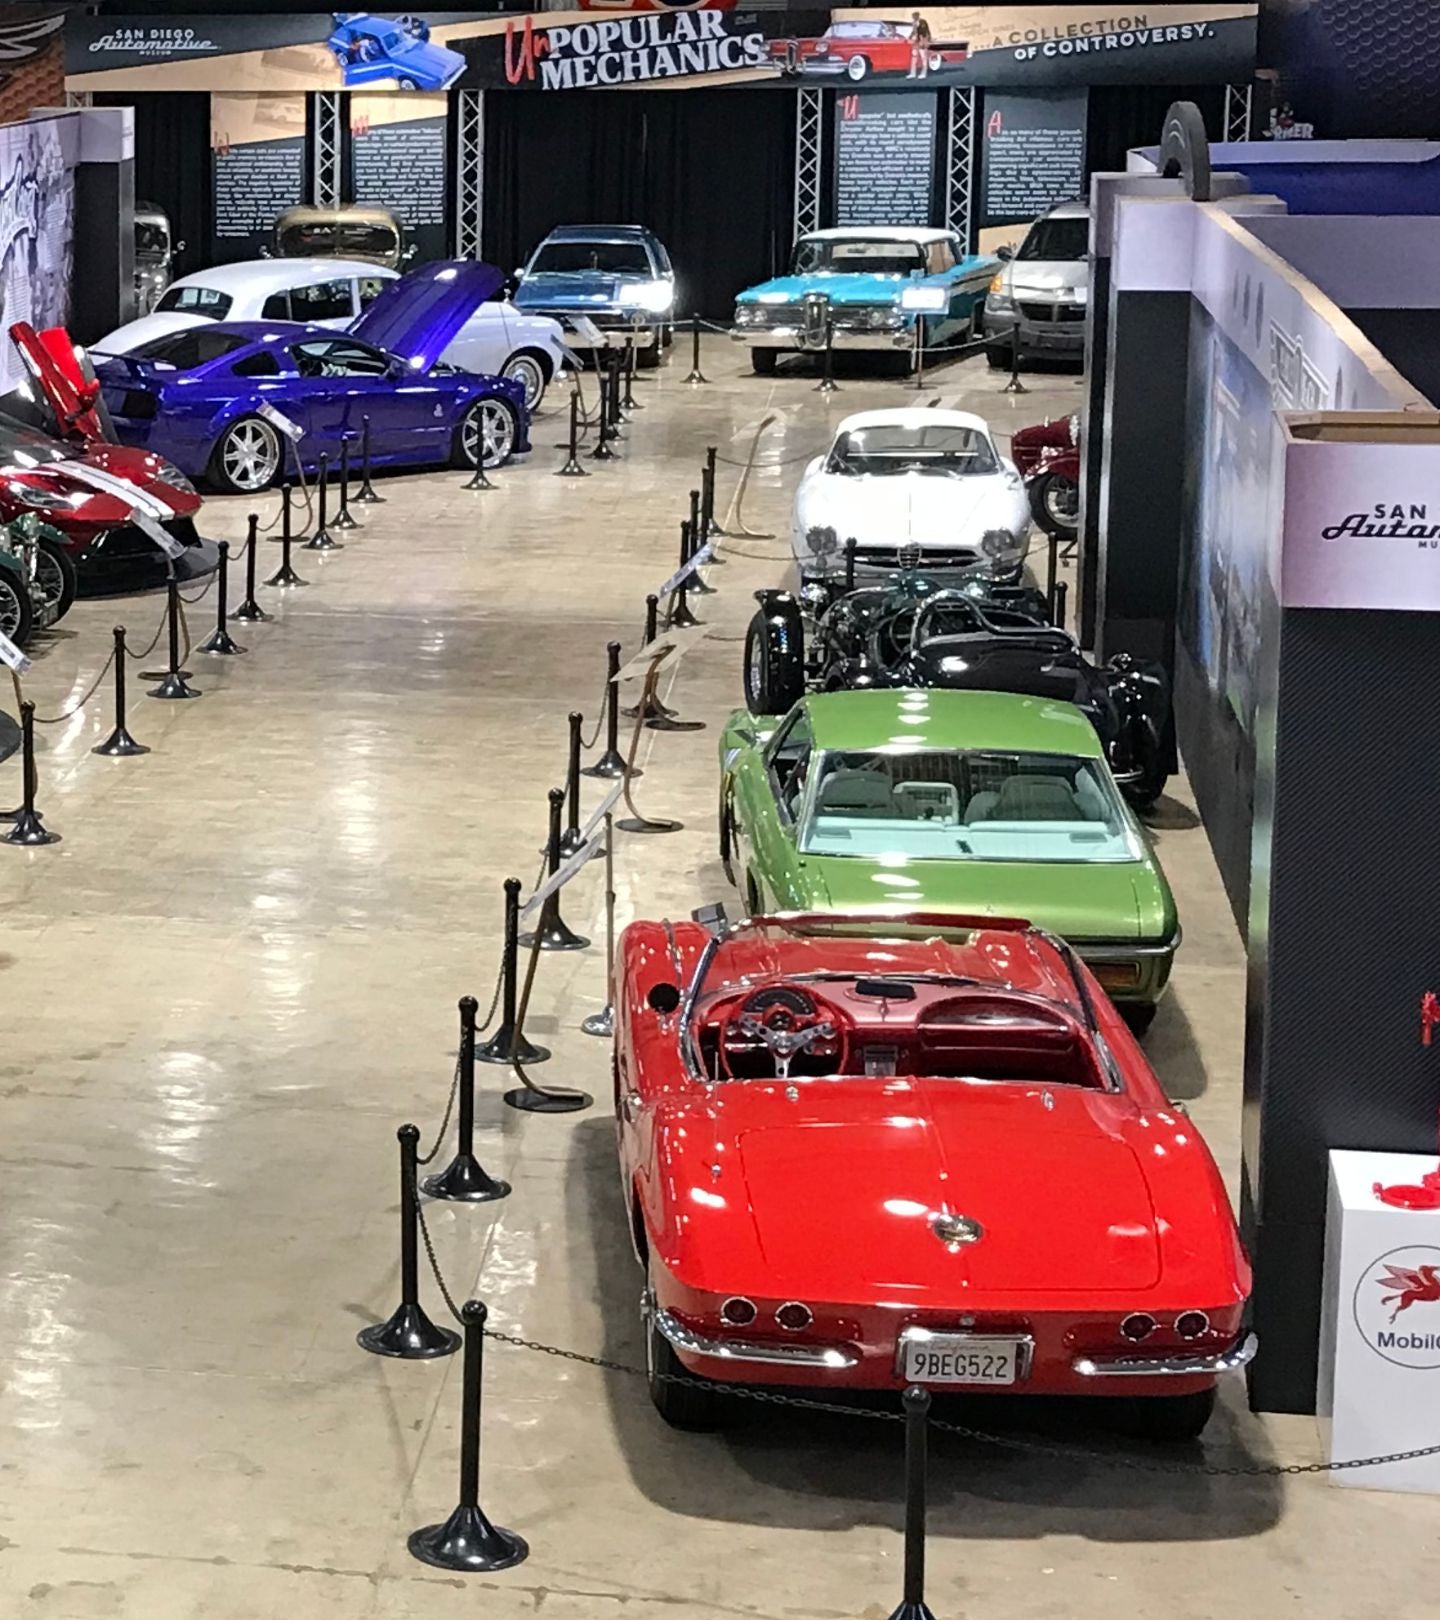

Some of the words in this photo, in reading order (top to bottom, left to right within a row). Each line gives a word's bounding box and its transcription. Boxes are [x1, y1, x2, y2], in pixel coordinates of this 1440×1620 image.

[115, 29, 144, 39] SAN
[150, 29, 194, 39] DIEGO
[1009, 15, 1148, 45] COLLECTION
[88, 35, 220, 52] Automotive
[539, 33, 768, 91] MECHANICS
[1014, 47, 1037, 60] OF
[1374, 504, 1426, 519] SAN
[913, 1352, 1009, 1378] 9BEG522
